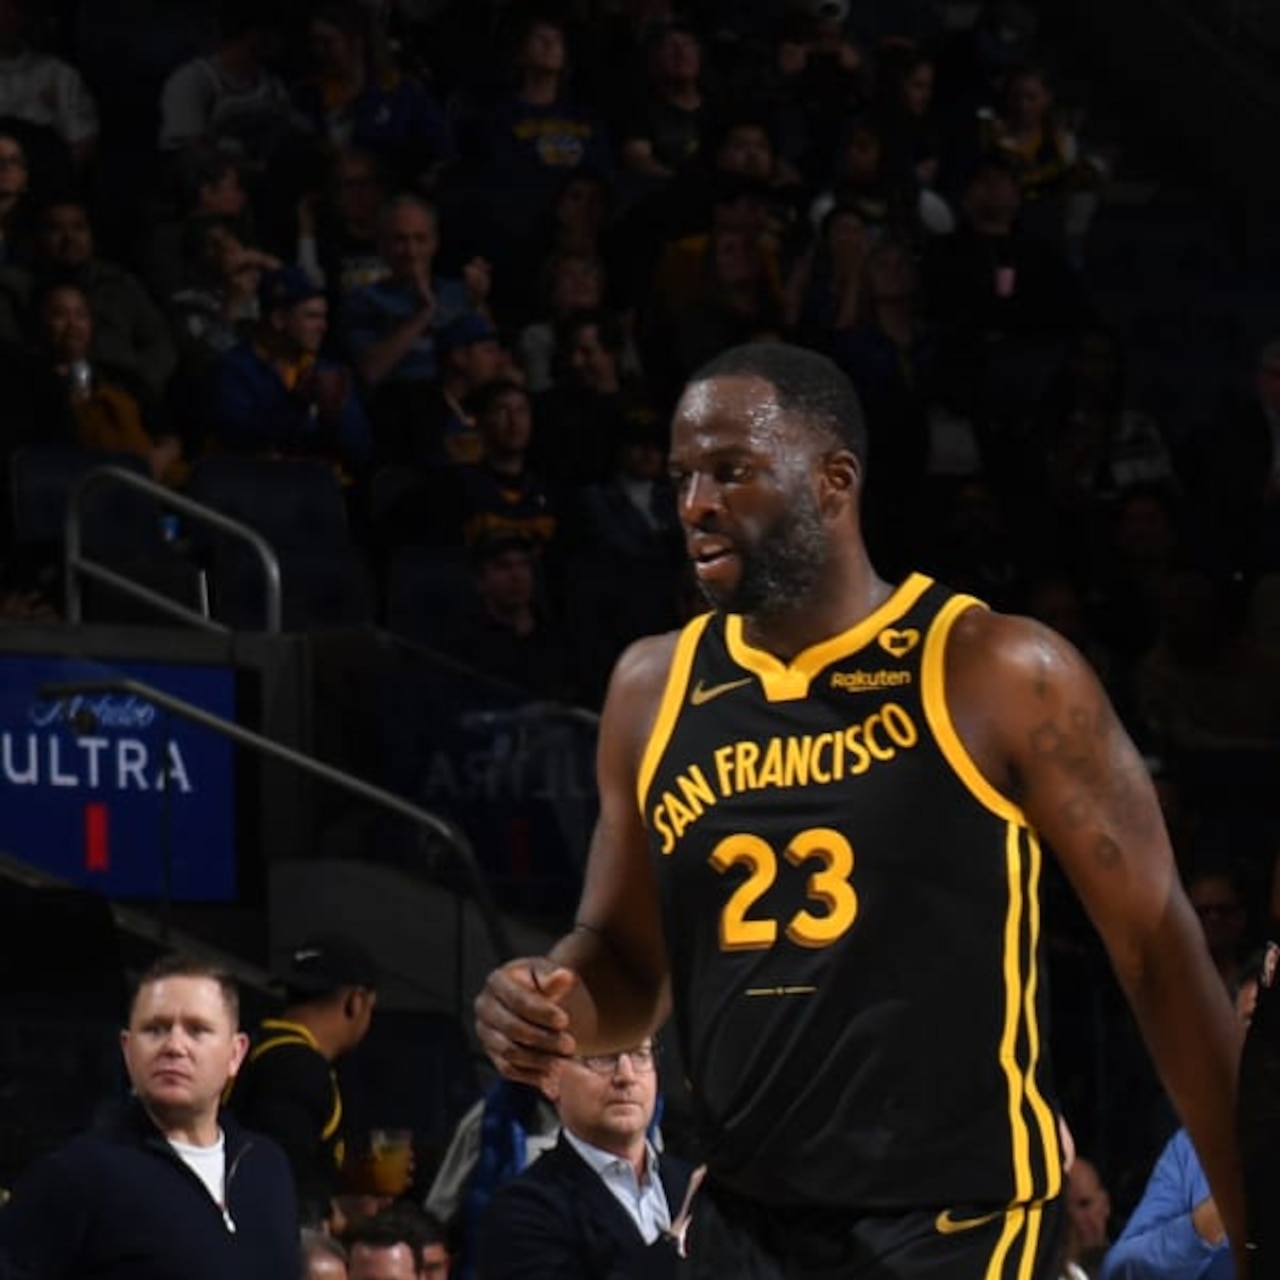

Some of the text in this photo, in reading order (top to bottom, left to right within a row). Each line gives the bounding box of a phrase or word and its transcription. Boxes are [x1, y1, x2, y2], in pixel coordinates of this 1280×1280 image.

[829, 668, 912, 692] Rakuten
[2, 732, 193, 794] ULTRA
[652, 701, 919, 856] SAN FRANCISCO
[707, 826, 860, 952] 23
